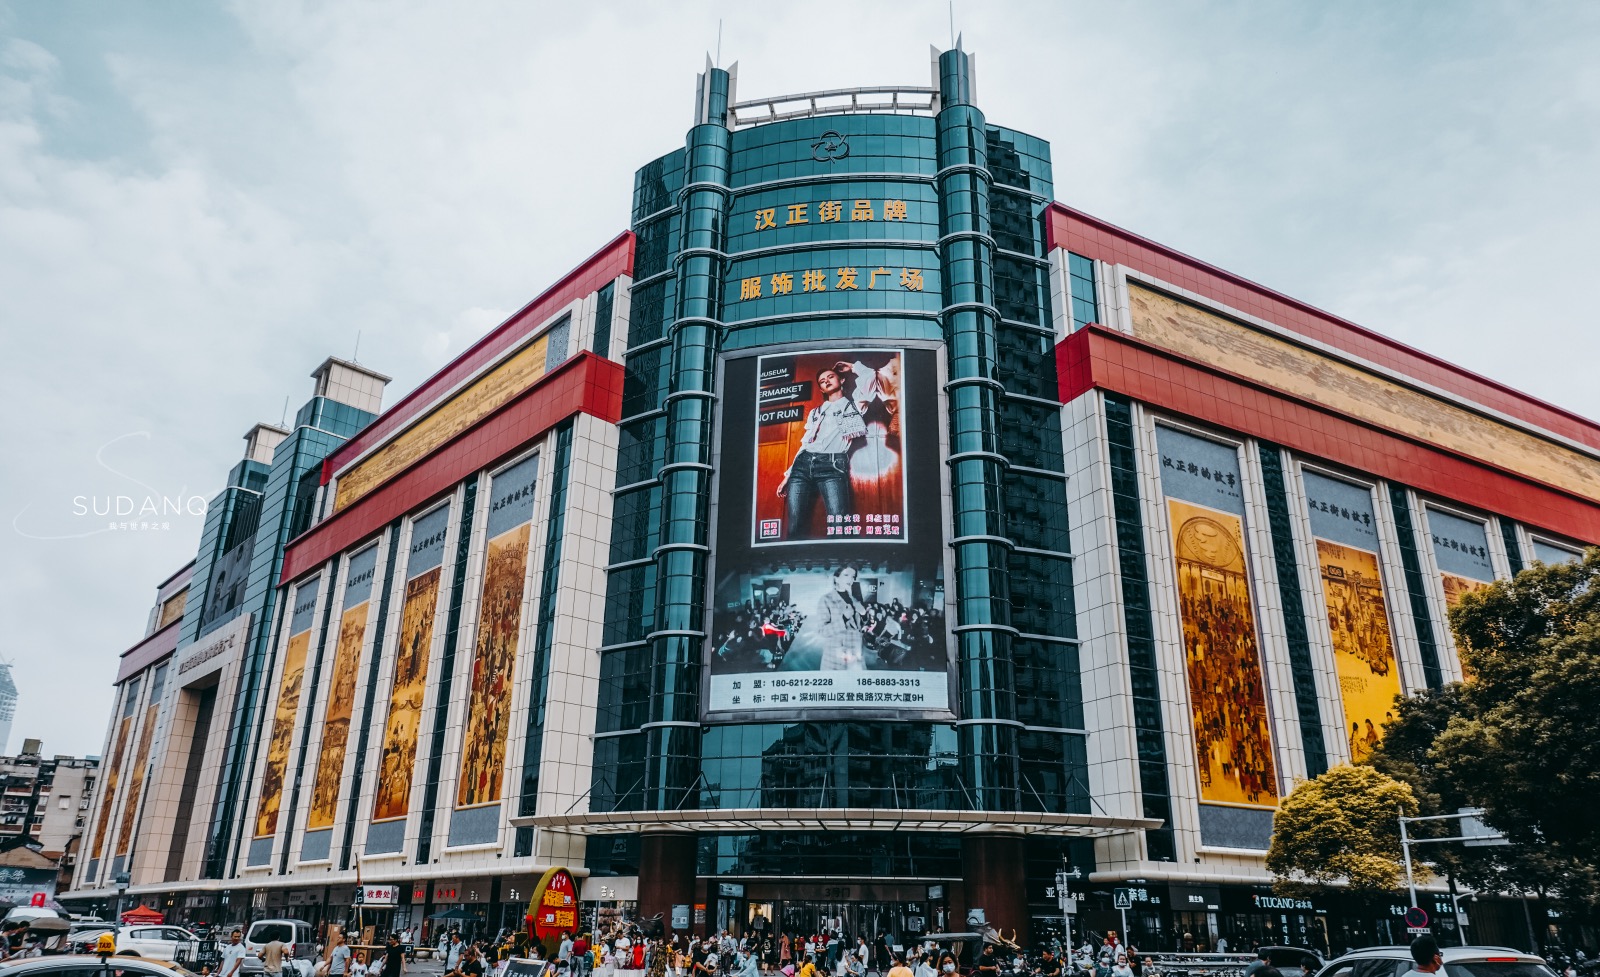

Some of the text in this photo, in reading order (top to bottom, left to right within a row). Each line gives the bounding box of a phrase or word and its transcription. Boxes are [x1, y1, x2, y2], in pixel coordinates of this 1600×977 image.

[754, 200, 908, 232] 汉正街品牌
[739, 266, 924, 301] 服饰批发广场
[776, 408, 799, 420] RUN
[1162, 455, 1236, 489] 汉正街的故事
[1308, 497, 1371, 528] 汉正街的故事
[770, 678, 834, 688] 180-6212-2228
[856, 677, 921, 688] 186-8883-3313
[364, 889, 391, 900] 收费处
[1260, 896, 1294, 909] TUCANO
